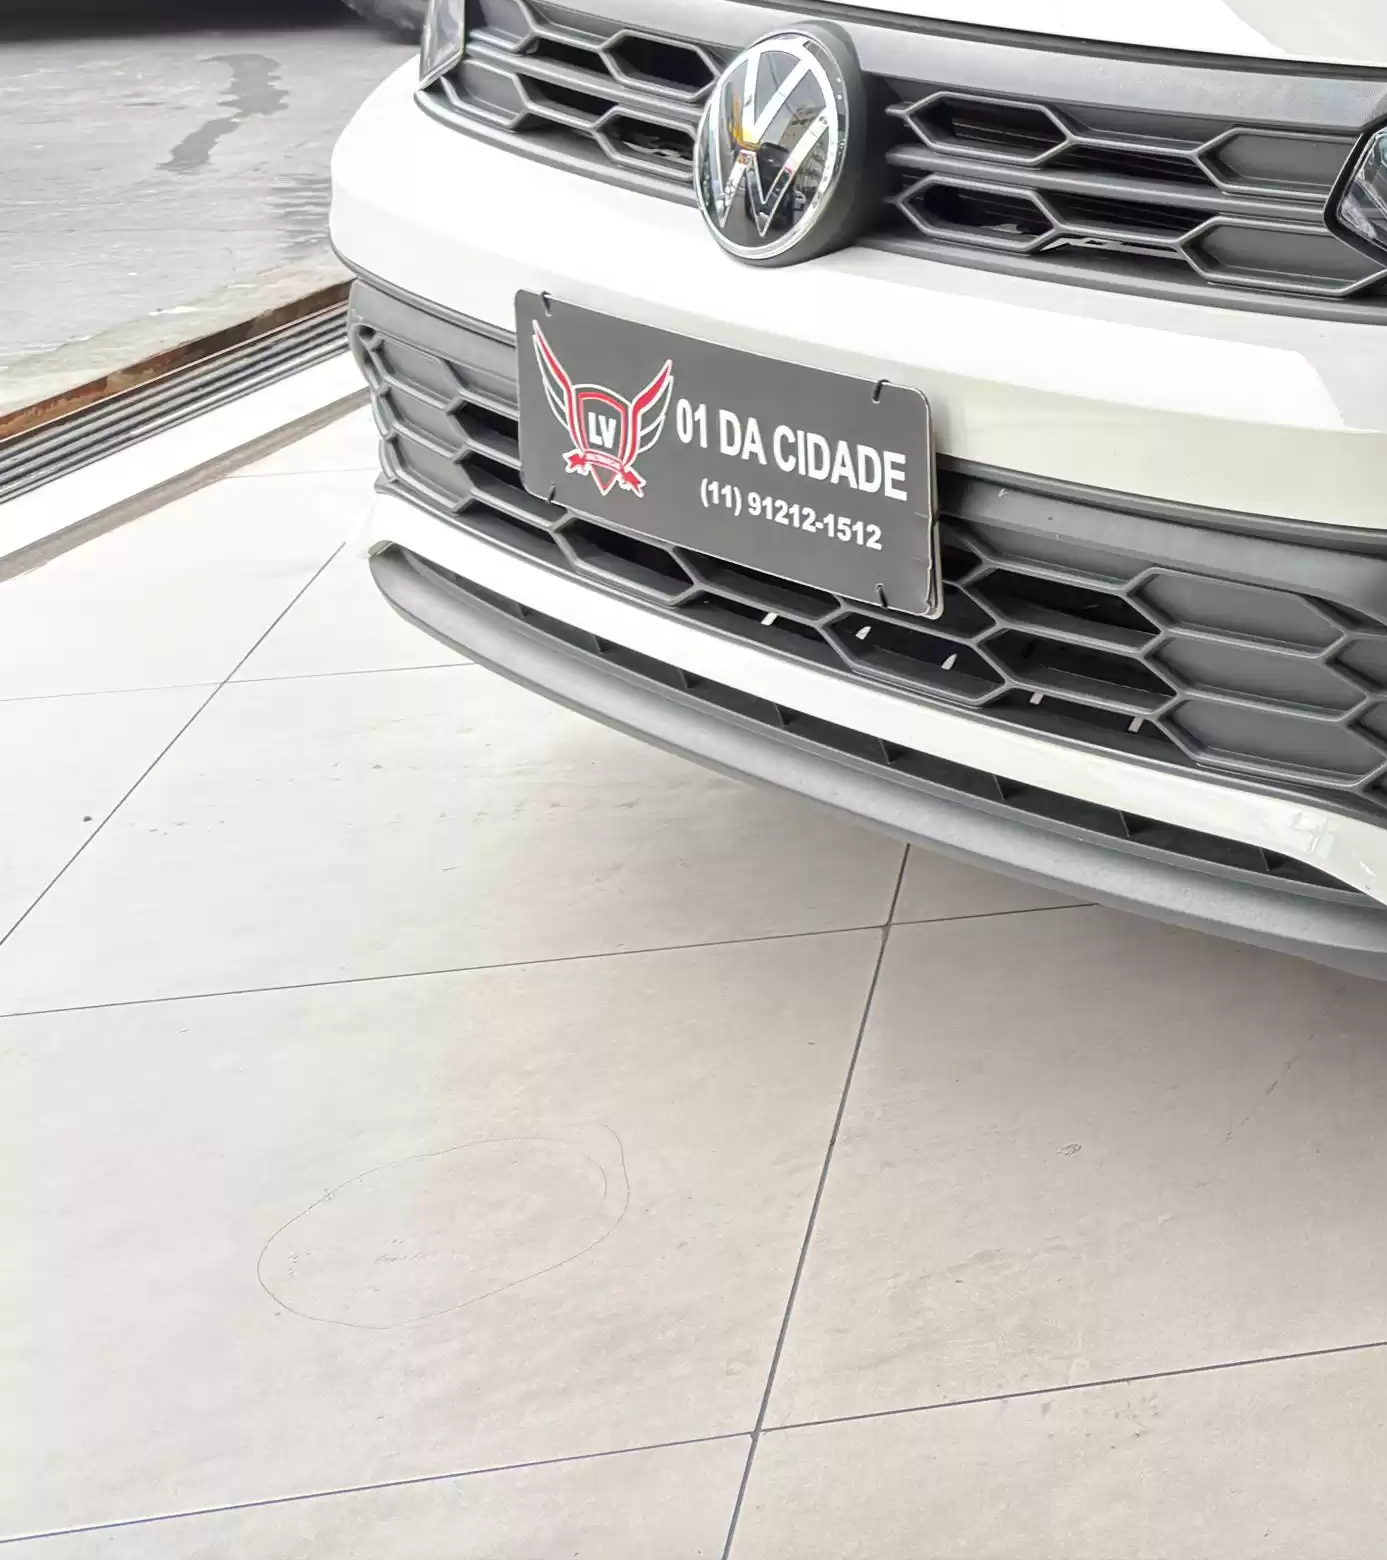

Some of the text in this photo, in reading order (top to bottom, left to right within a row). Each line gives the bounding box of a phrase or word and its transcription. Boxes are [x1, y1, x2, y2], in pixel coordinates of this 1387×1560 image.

[587, 411, 617, 449] LV
[676, 398, 908, 502] 01 DA CIDADE
[700, 478, 882, 551] (11) 91212-1512
